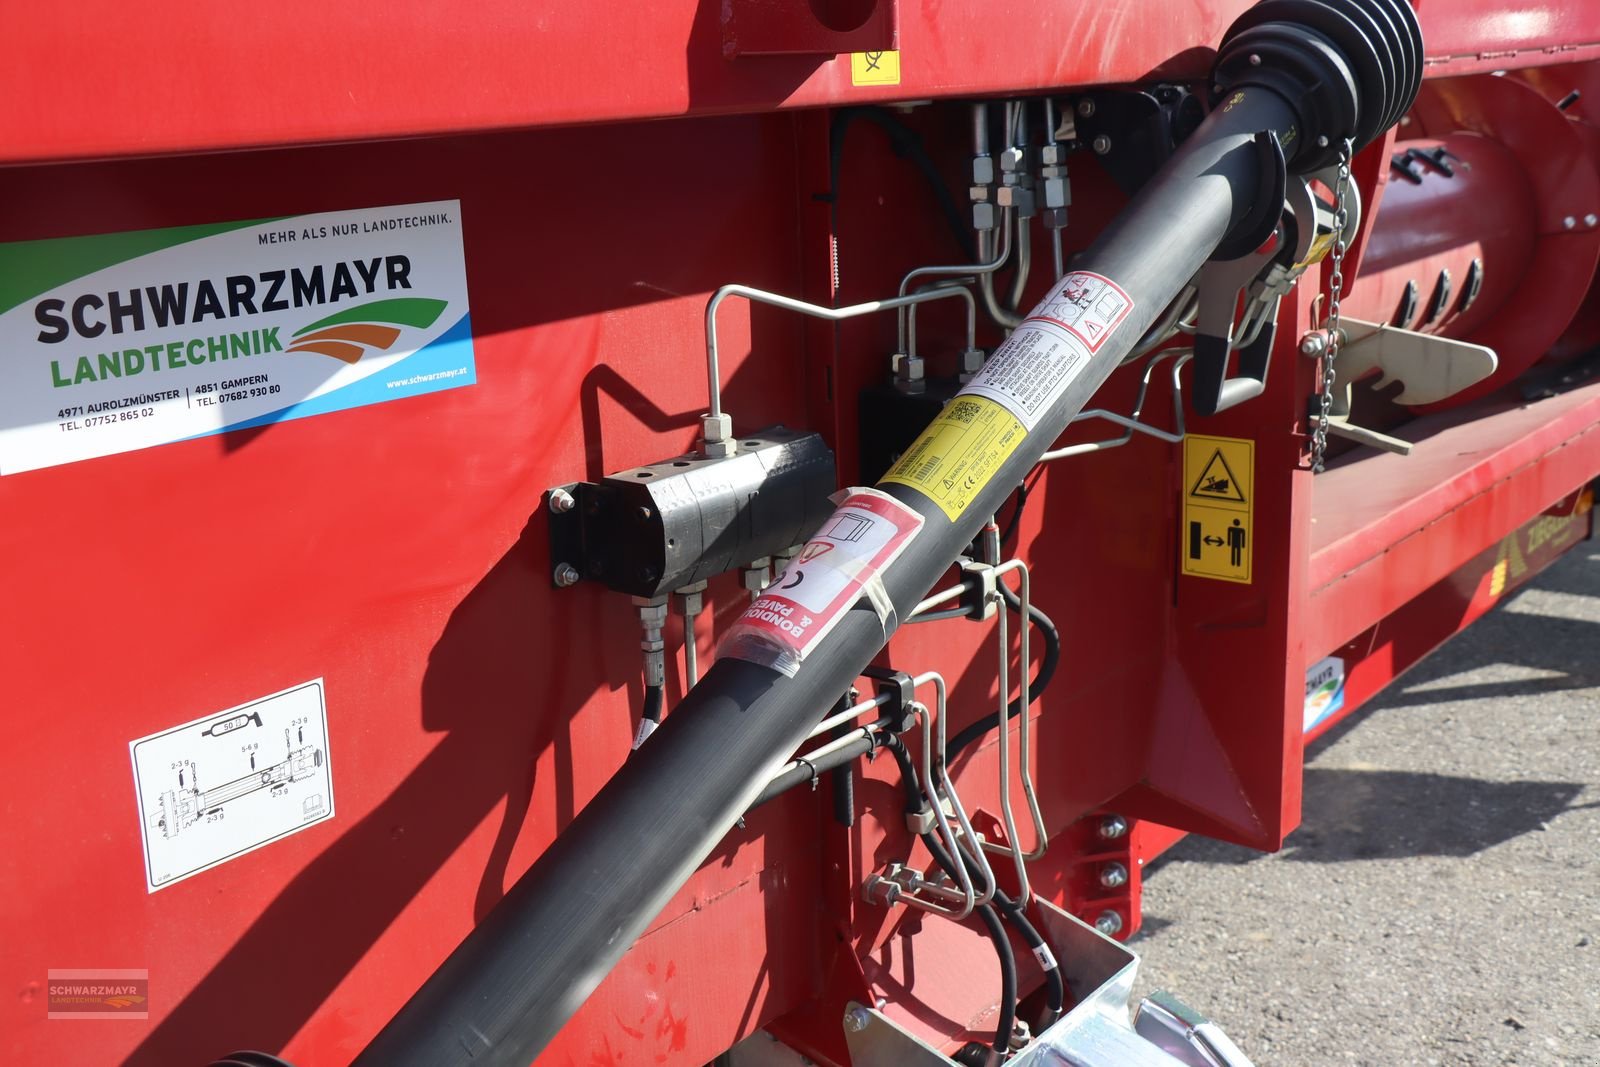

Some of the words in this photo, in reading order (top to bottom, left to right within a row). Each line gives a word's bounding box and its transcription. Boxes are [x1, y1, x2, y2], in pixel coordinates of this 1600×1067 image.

[258, 232, 296, 245] MEHR
[302, 226, 327, 241] ALS
[332, 223, 359, 238] NUR
[364, 213, 452, 233] LANDTECHNIK.
[34, 254, 412, 344] SCHWARZMAYR
[50, 326, 283, 388] LANDTECHNIK
[194, 381, 218, 394] 4851
[221, 374, 269, 392] GAMPERN
[386, 366, 468, 388] www.schwarzmayr.at
[1026, 401, 1035, 411] DO
[1031, 392, 1043, 404] NOT
[1039, 383, 1050, 394] USE
[1047, 374, 1058, 386] PTO
[1054, 352, 1077, 377] ADAPTORS
[58, 404, 84, 418] 4971
[87, 389, 180, 415] AUROLZMÜNSTER
[196, 394, 218, 407] TEL.
[218, 390, 248, 404] 07682
[250, 386, 268, 400] 930
[269, 384, 281, 396] 80
[59, 420, 82, 432] TEL.
[85, 413, 118, 428] 07752
[119, 410, 139, 424] 865
[141, 407, 154, 420] 02
[801, 615, 813, 627] &
